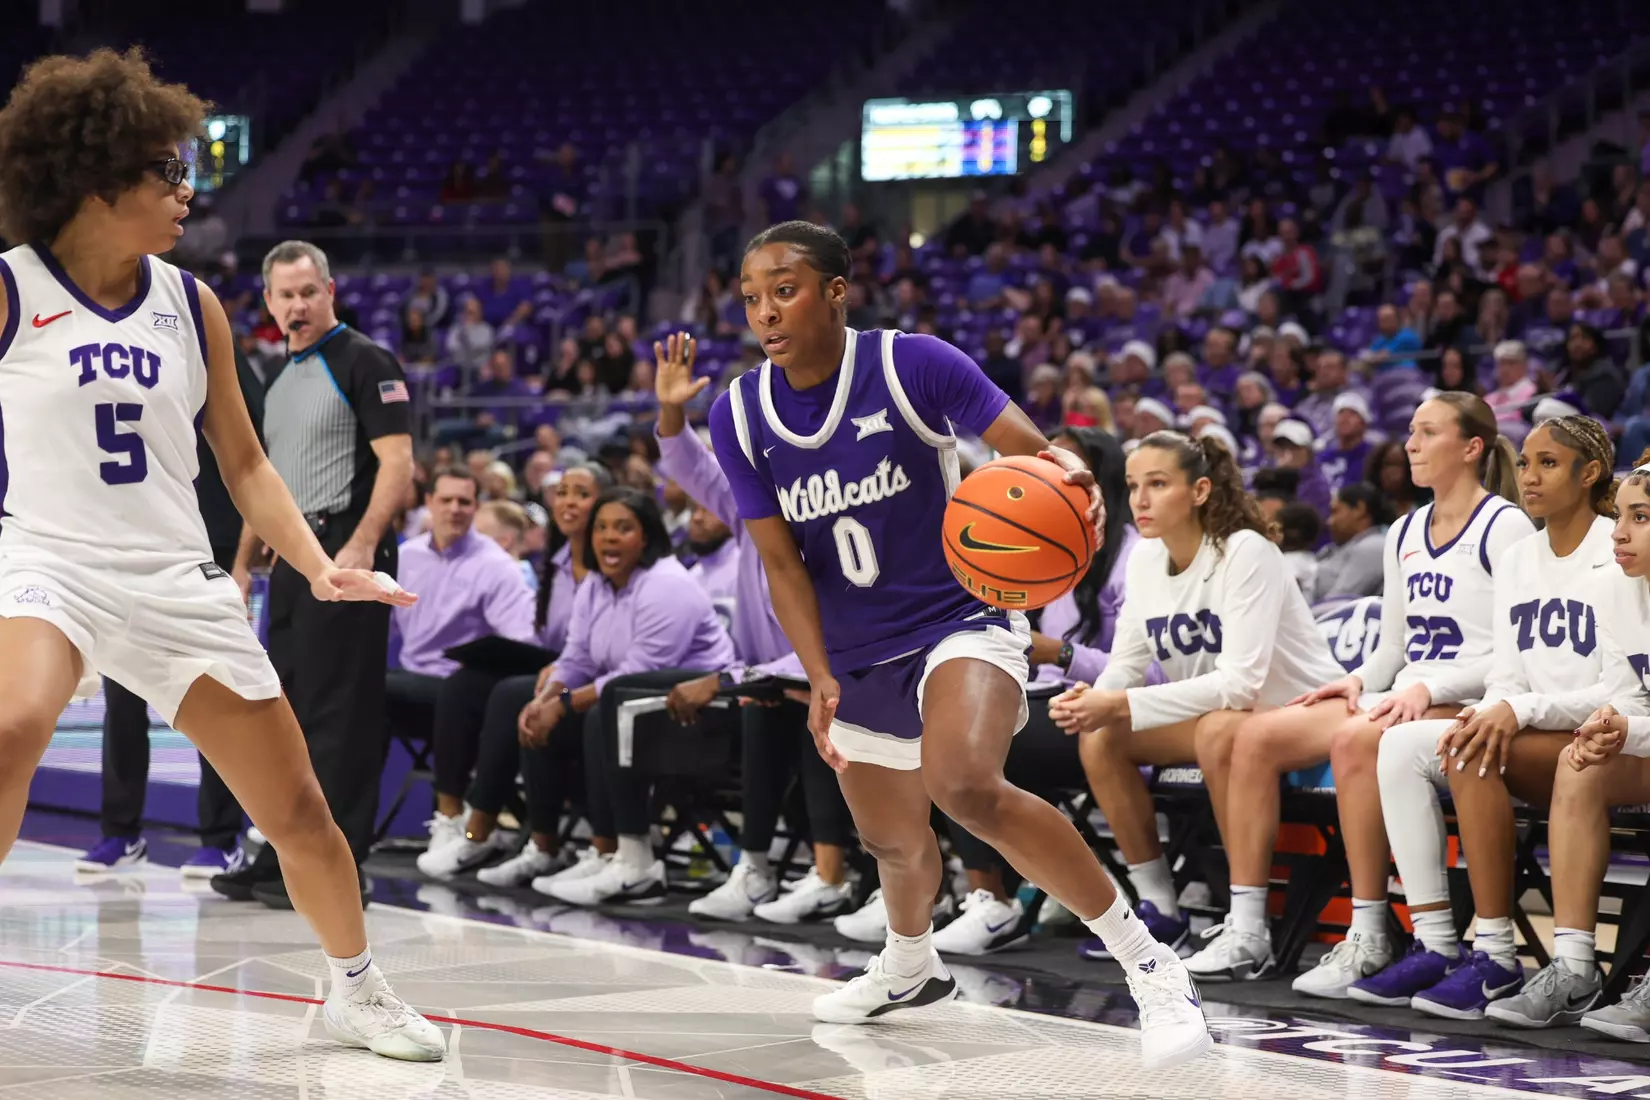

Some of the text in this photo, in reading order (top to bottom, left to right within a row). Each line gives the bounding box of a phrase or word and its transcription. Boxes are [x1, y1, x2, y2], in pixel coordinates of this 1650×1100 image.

[69, 343, 161, 389] TCU
[95, 403, 148, 485] 5
[775, 455, 911, 522] Wildcats
[832, 516, 880, 587] 0
[952, 560, 1028, 606] ELITE
[1407, 572, 1453, 603] TCU
[1146, 608, 1222, 661] TCU
[1406, 615, 1464, 662] 22
[1510, 598, 1597, 658] TCU
